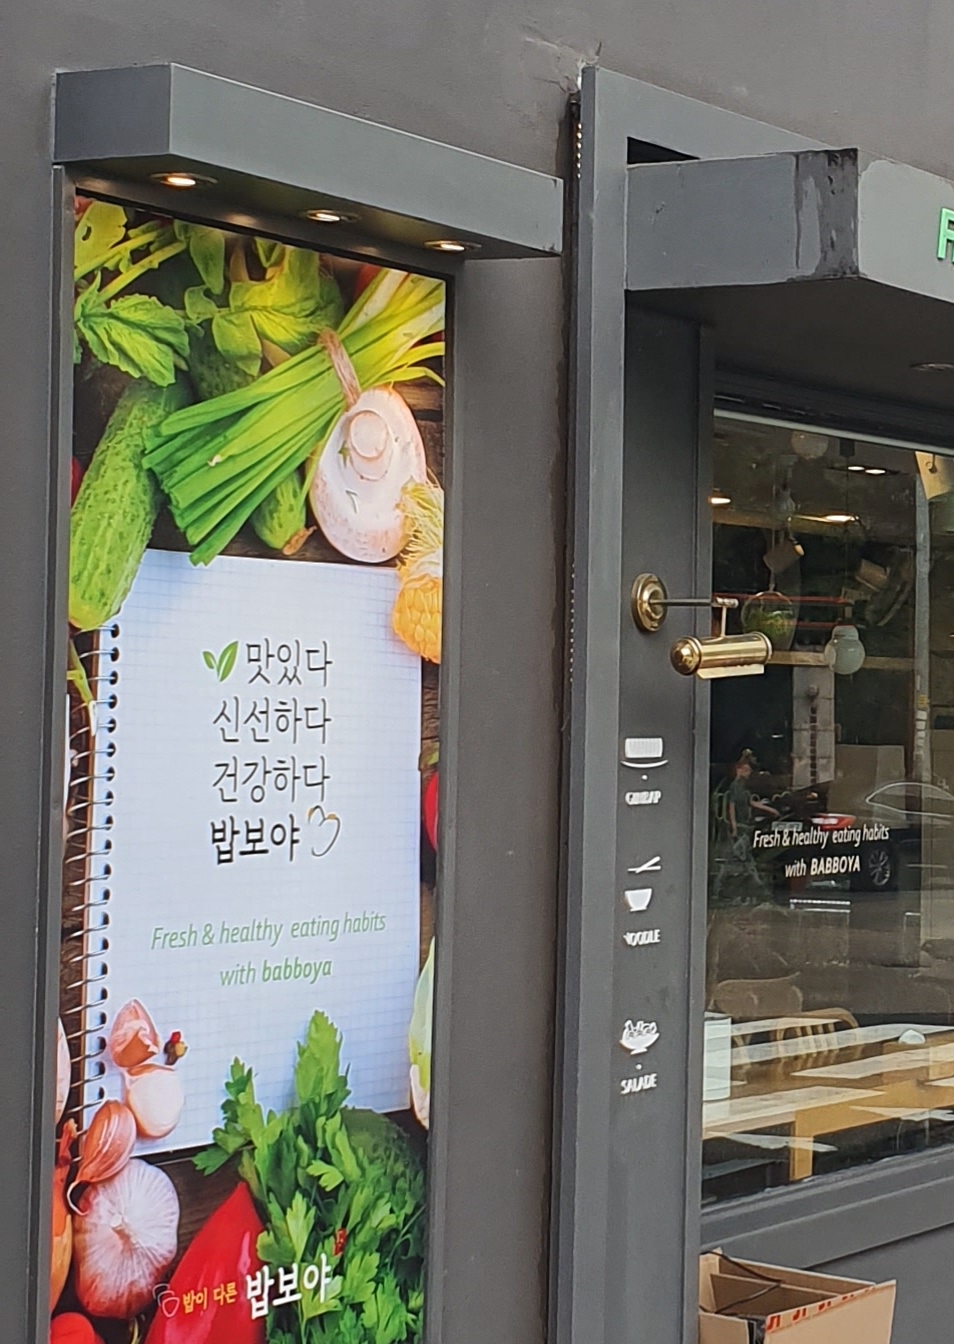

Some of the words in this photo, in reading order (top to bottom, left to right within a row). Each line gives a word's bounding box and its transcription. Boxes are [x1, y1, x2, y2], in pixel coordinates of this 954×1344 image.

[245, 638, 333, 687] 맛있다
[212, 696, 333, 745] 신선하다
[211, 755, 331, 803] 건강하다
[210, 813, 301, 865] 밥보야
[752, 829, 781, 849] Fresh
[782, 829, 791, 847] &
[791, 826, 830, 850] healthy
[832, 826, 861, 848] eating
[862, 822, 890, 842] habits
[784, 858, 807, 878] with
[810, 854, 861, 877] BABBOYA
[151, 923, 198, 950] Fresh
[202, 921, 215, 946] &
[219, 917, 283, 948] healthy
[290, 914, 340, 942] eating
[343, 910, 387, 935] habits
[220, 961, 256, 987] with
[261, 957, 332, 987] babboya
[182, 1286, 208, 1314] 밥이
[213, 1282, 238, 1306] 다른
[245, 1253, 333, 1320] 밥보야
